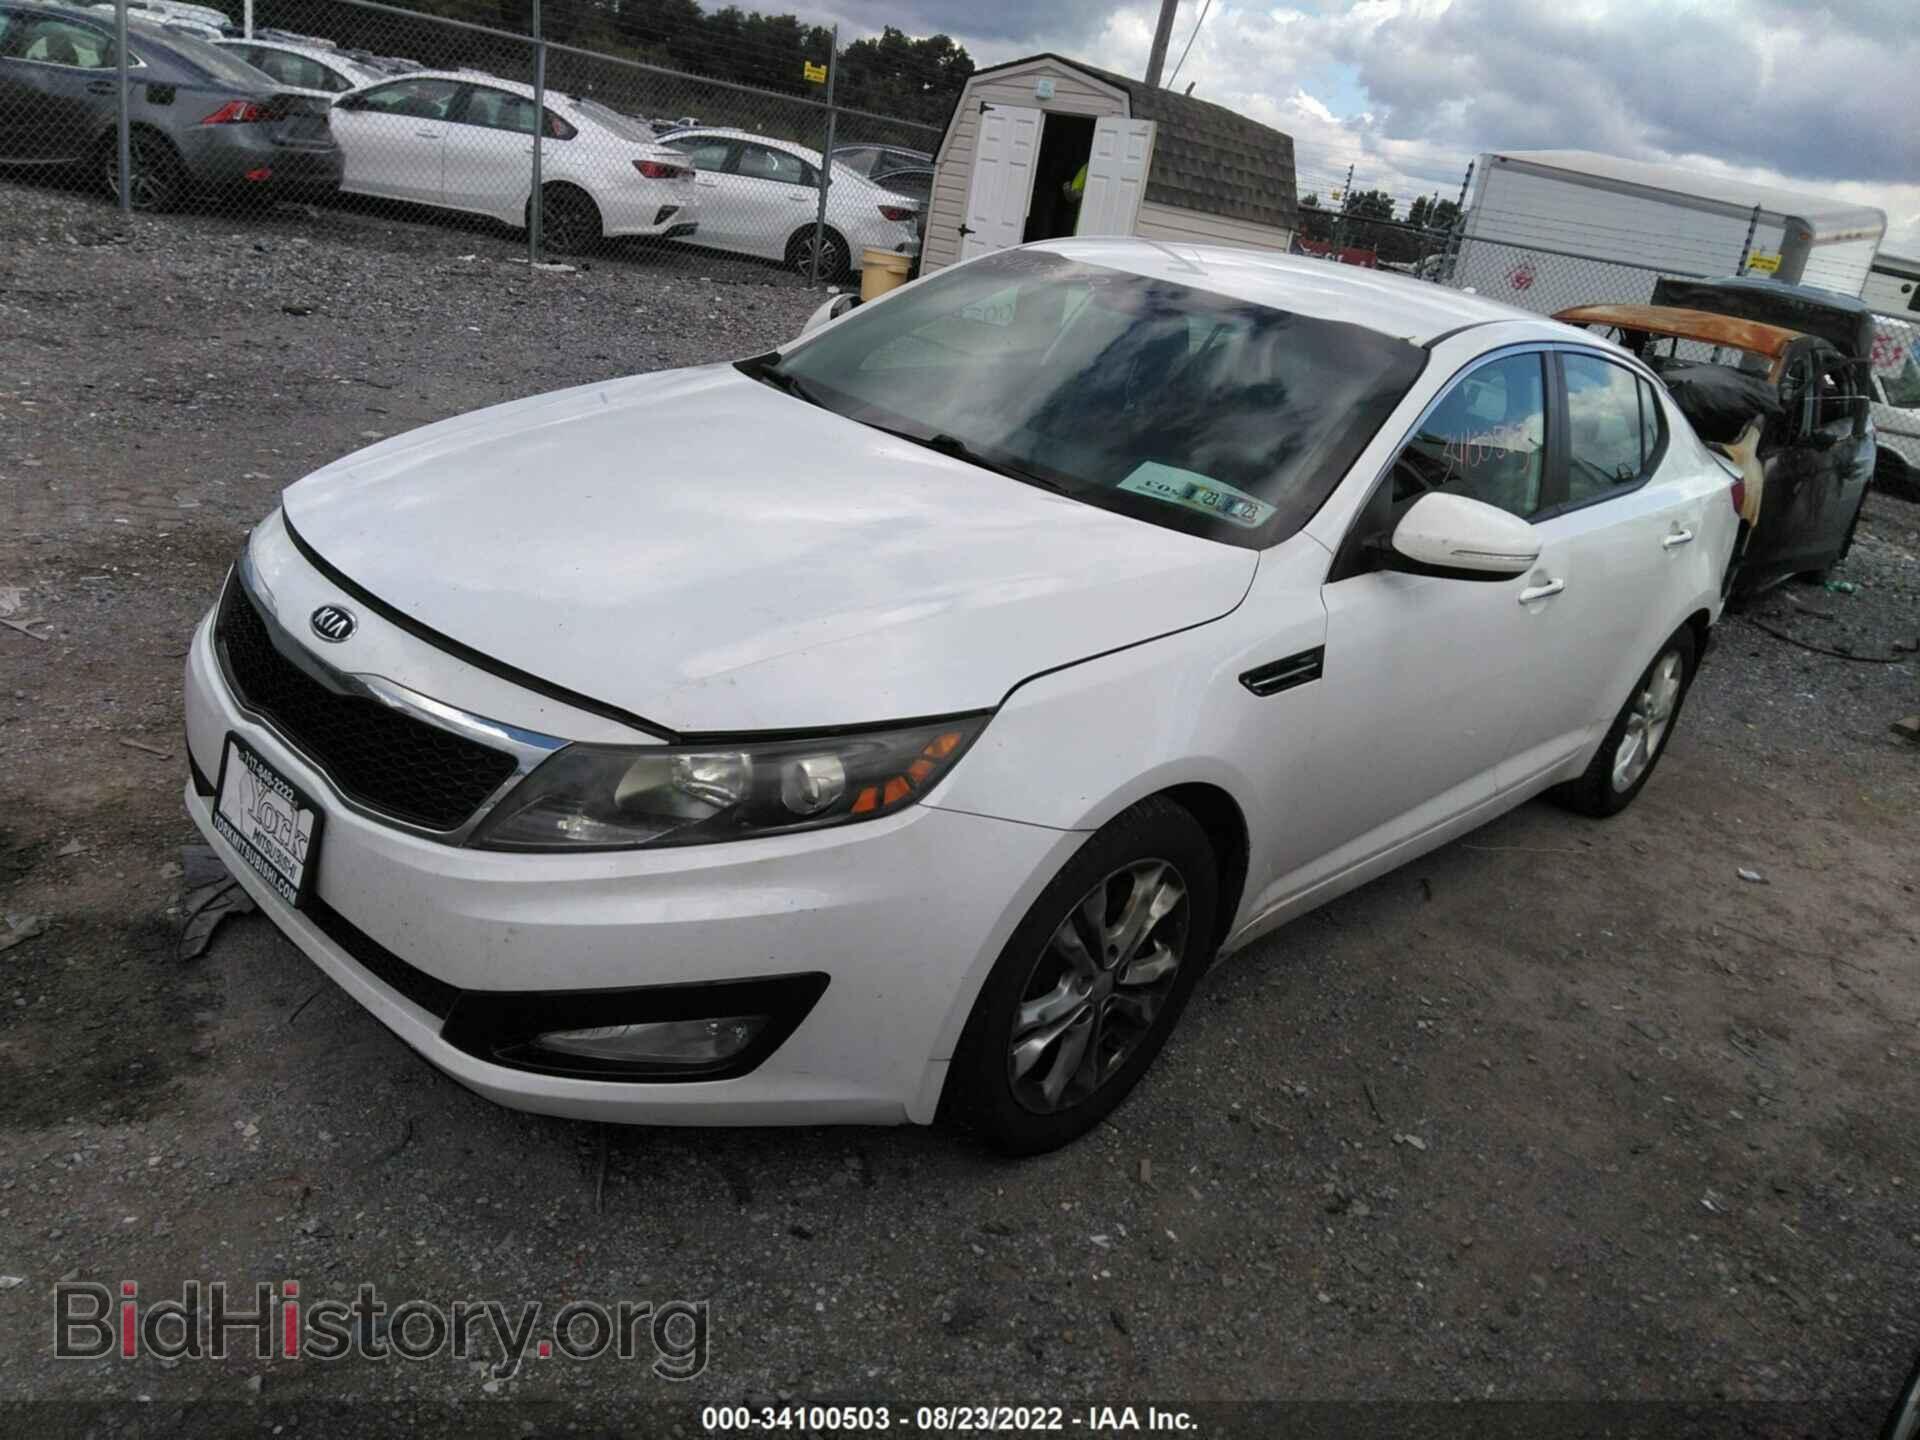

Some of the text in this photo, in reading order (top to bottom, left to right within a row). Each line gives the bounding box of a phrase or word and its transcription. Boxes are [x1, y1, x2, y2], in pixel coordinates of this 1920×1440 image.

[314, 607, 348, 638] KIA
[246, 768, 309, 867] York
[252, 826, 298, 881] MITSUBISHI
[213, 811, 298, 906] YORKMITSUBISHI.COM
